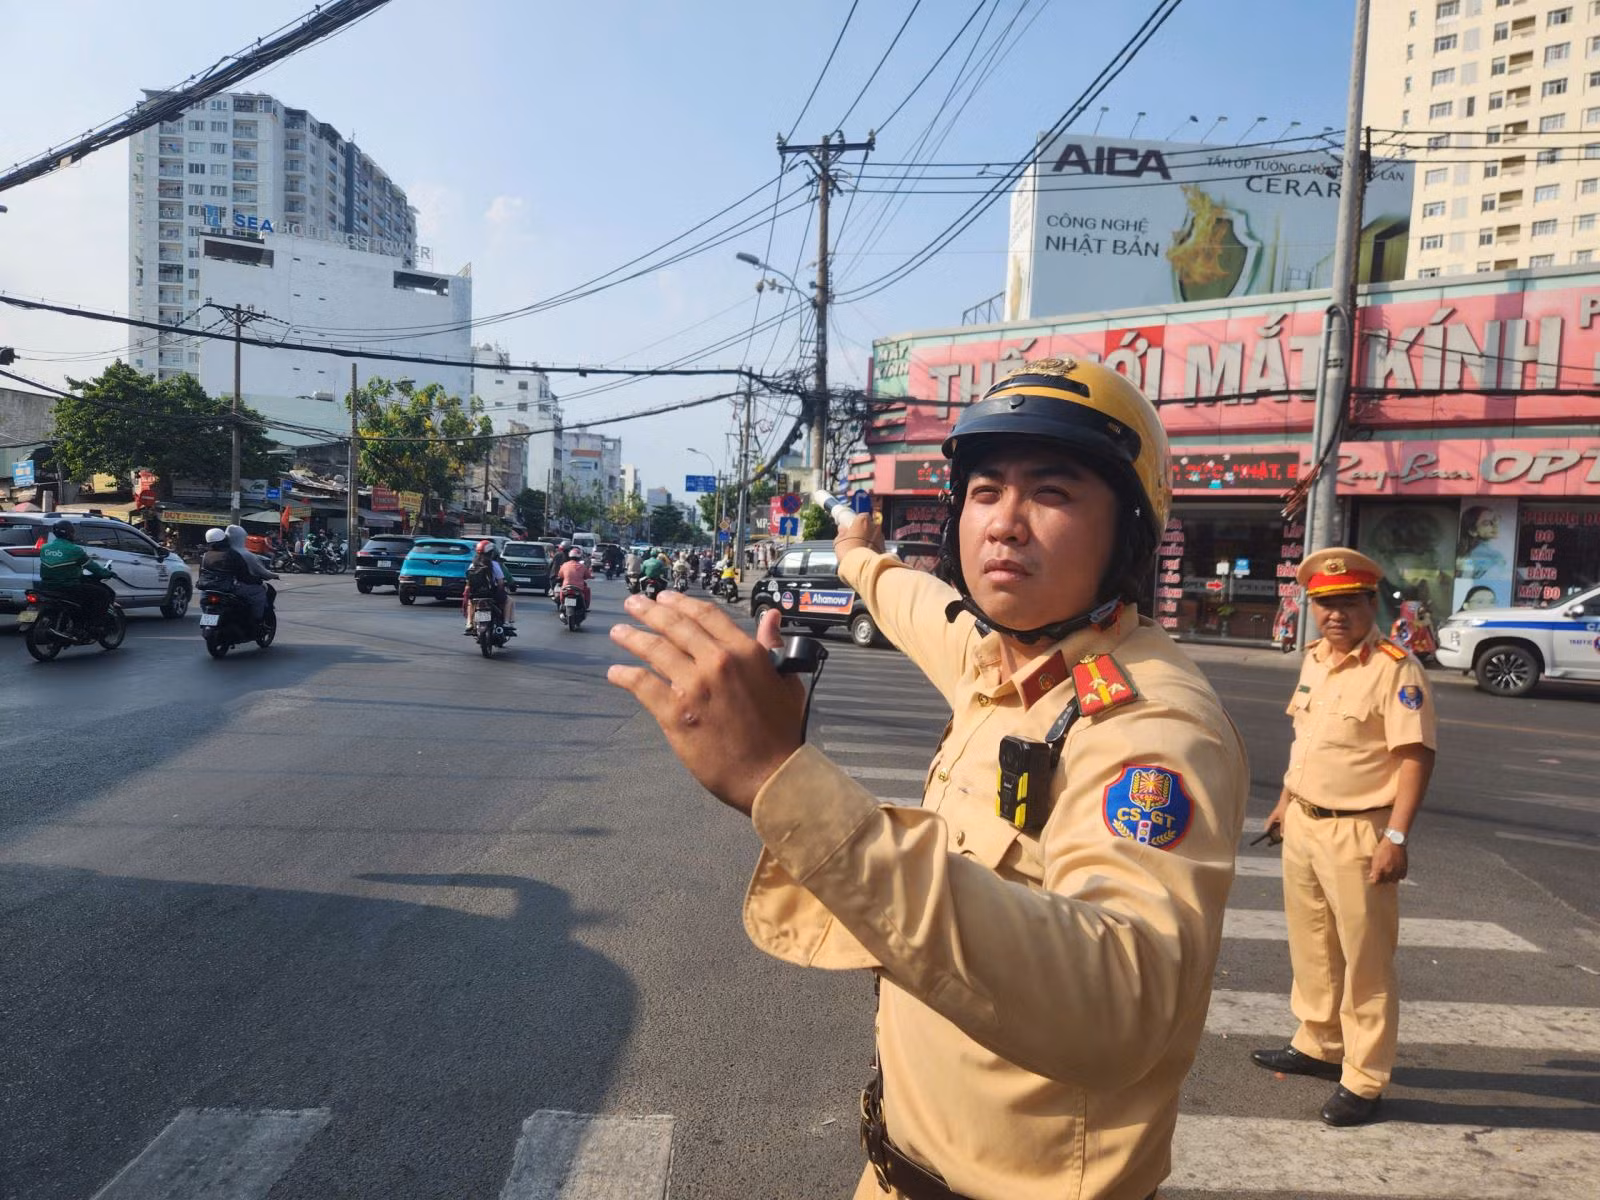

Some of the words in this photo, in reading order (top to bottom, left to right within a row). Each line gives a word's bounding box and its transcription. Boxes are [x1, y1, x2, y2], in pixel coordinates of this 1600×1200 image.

[1052, 144, 1172, 180] AICA
[1246, 176, 1341, 199] CERAR
[234, 214, 273, 233] SEA
[1046, 212, 1097, 229] CÔNG
[1101, 217, 1150, 234] NGHỆ
[1045, 233, 1107, 256] NHẬT
[1112, 235, 1159, 257] BẢN
[1184, 313, 1321, 408] MẮT
[1361, 306, 1563, 393] KÍNH
[45, 549, 63, 557] Grab
[812, 593, 848, 605] Ahamove
